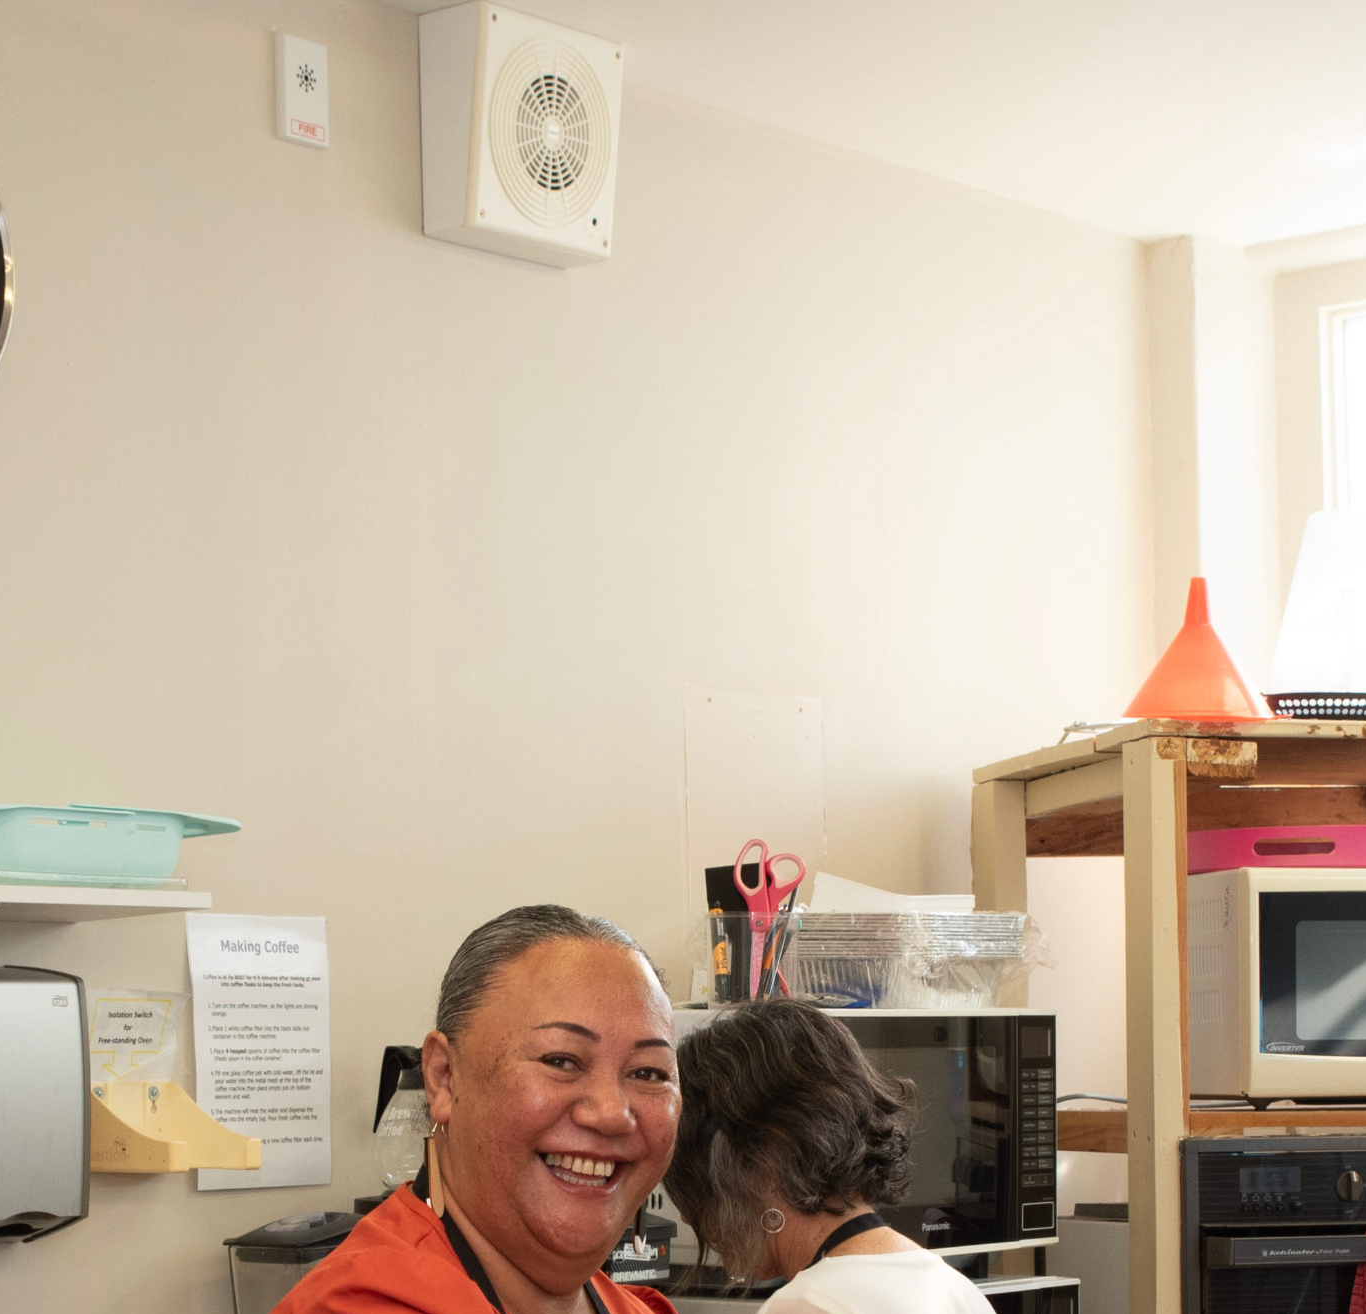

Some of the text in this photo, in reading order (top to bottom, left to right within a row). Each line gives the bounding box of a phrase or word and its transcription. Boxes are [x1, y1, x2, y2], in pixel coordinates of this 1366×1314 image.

[299, 123, 316, 136] FIRE
[221, 940, 300, 955] Making Coffee
[108, 1011, 153, 1019] Isolation Switch
[123, 1024, 132, 1032] for
[98, 1037, 153, 1045] Free-standing Oven
[1269, 1044, 1305, 1052] INVERTER
[921, 1221, 950, 1232] Panasonic
